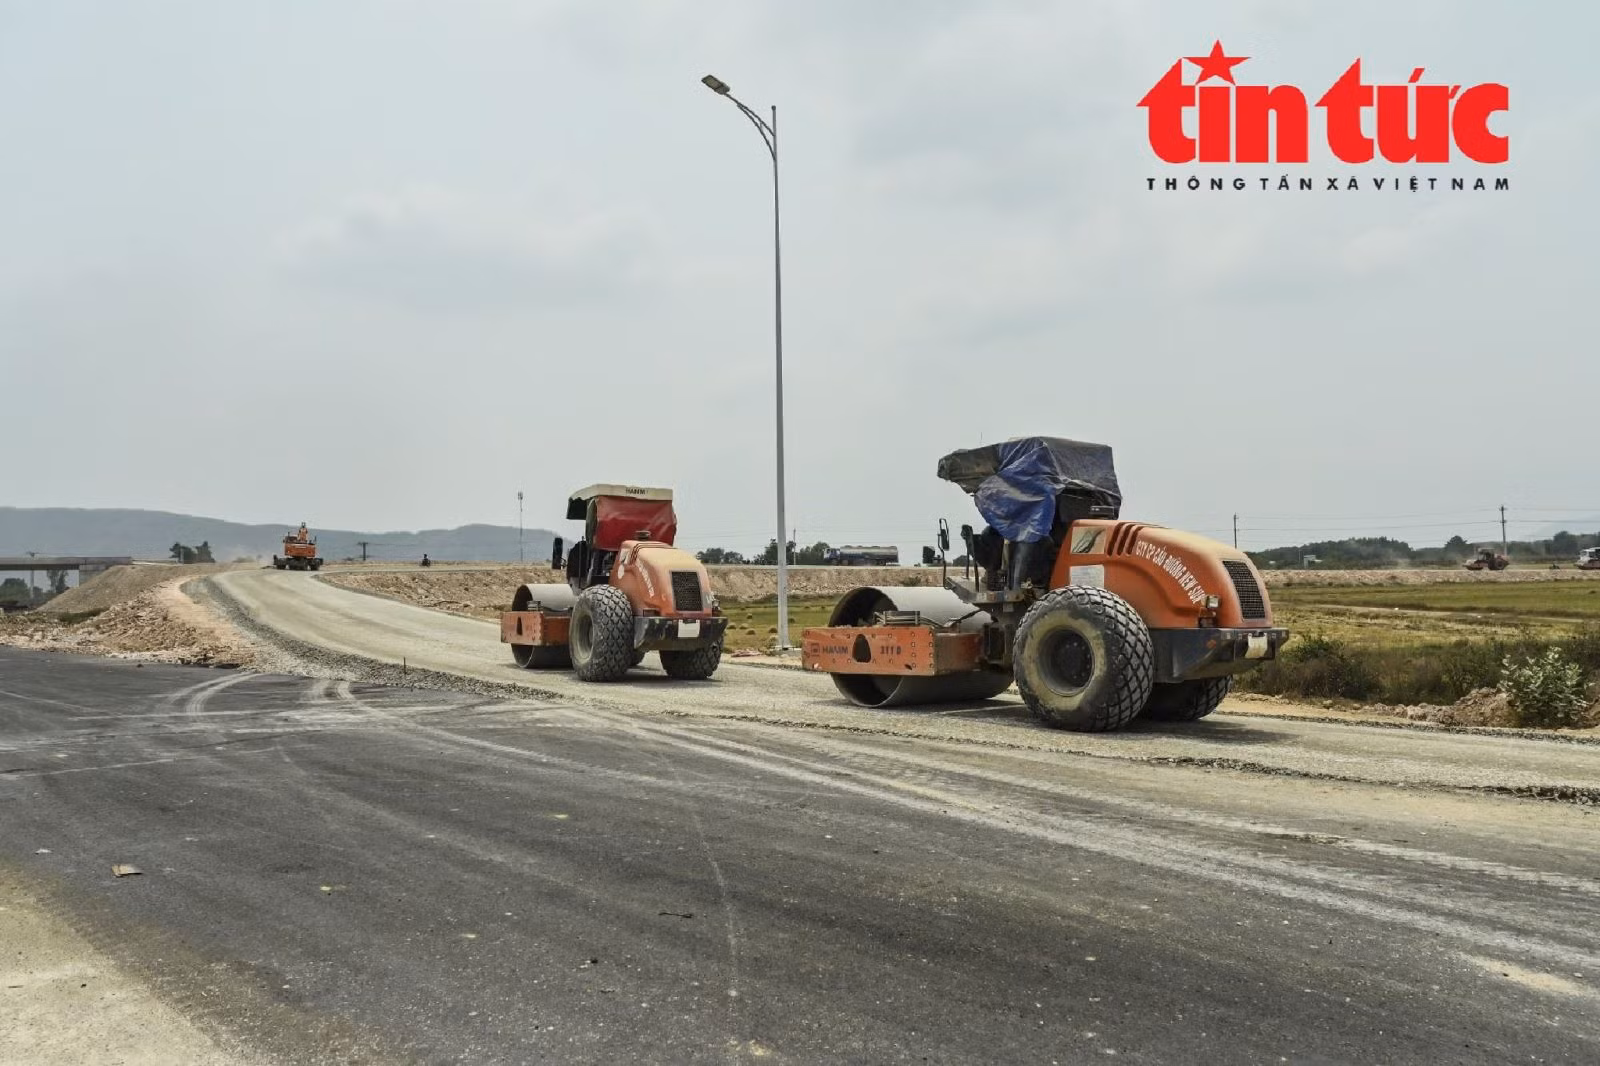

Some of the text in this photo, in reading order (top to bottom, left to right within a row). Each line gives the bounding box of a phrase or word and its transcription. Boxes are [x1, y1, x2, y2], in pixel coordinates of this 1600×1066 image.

[1136, 541, 1148, 557] CTY
[1146, 543, 1155, 560] CP
[1178, 569, 1198, 591] NEW
[822, 645, 848, 654] HAMM
